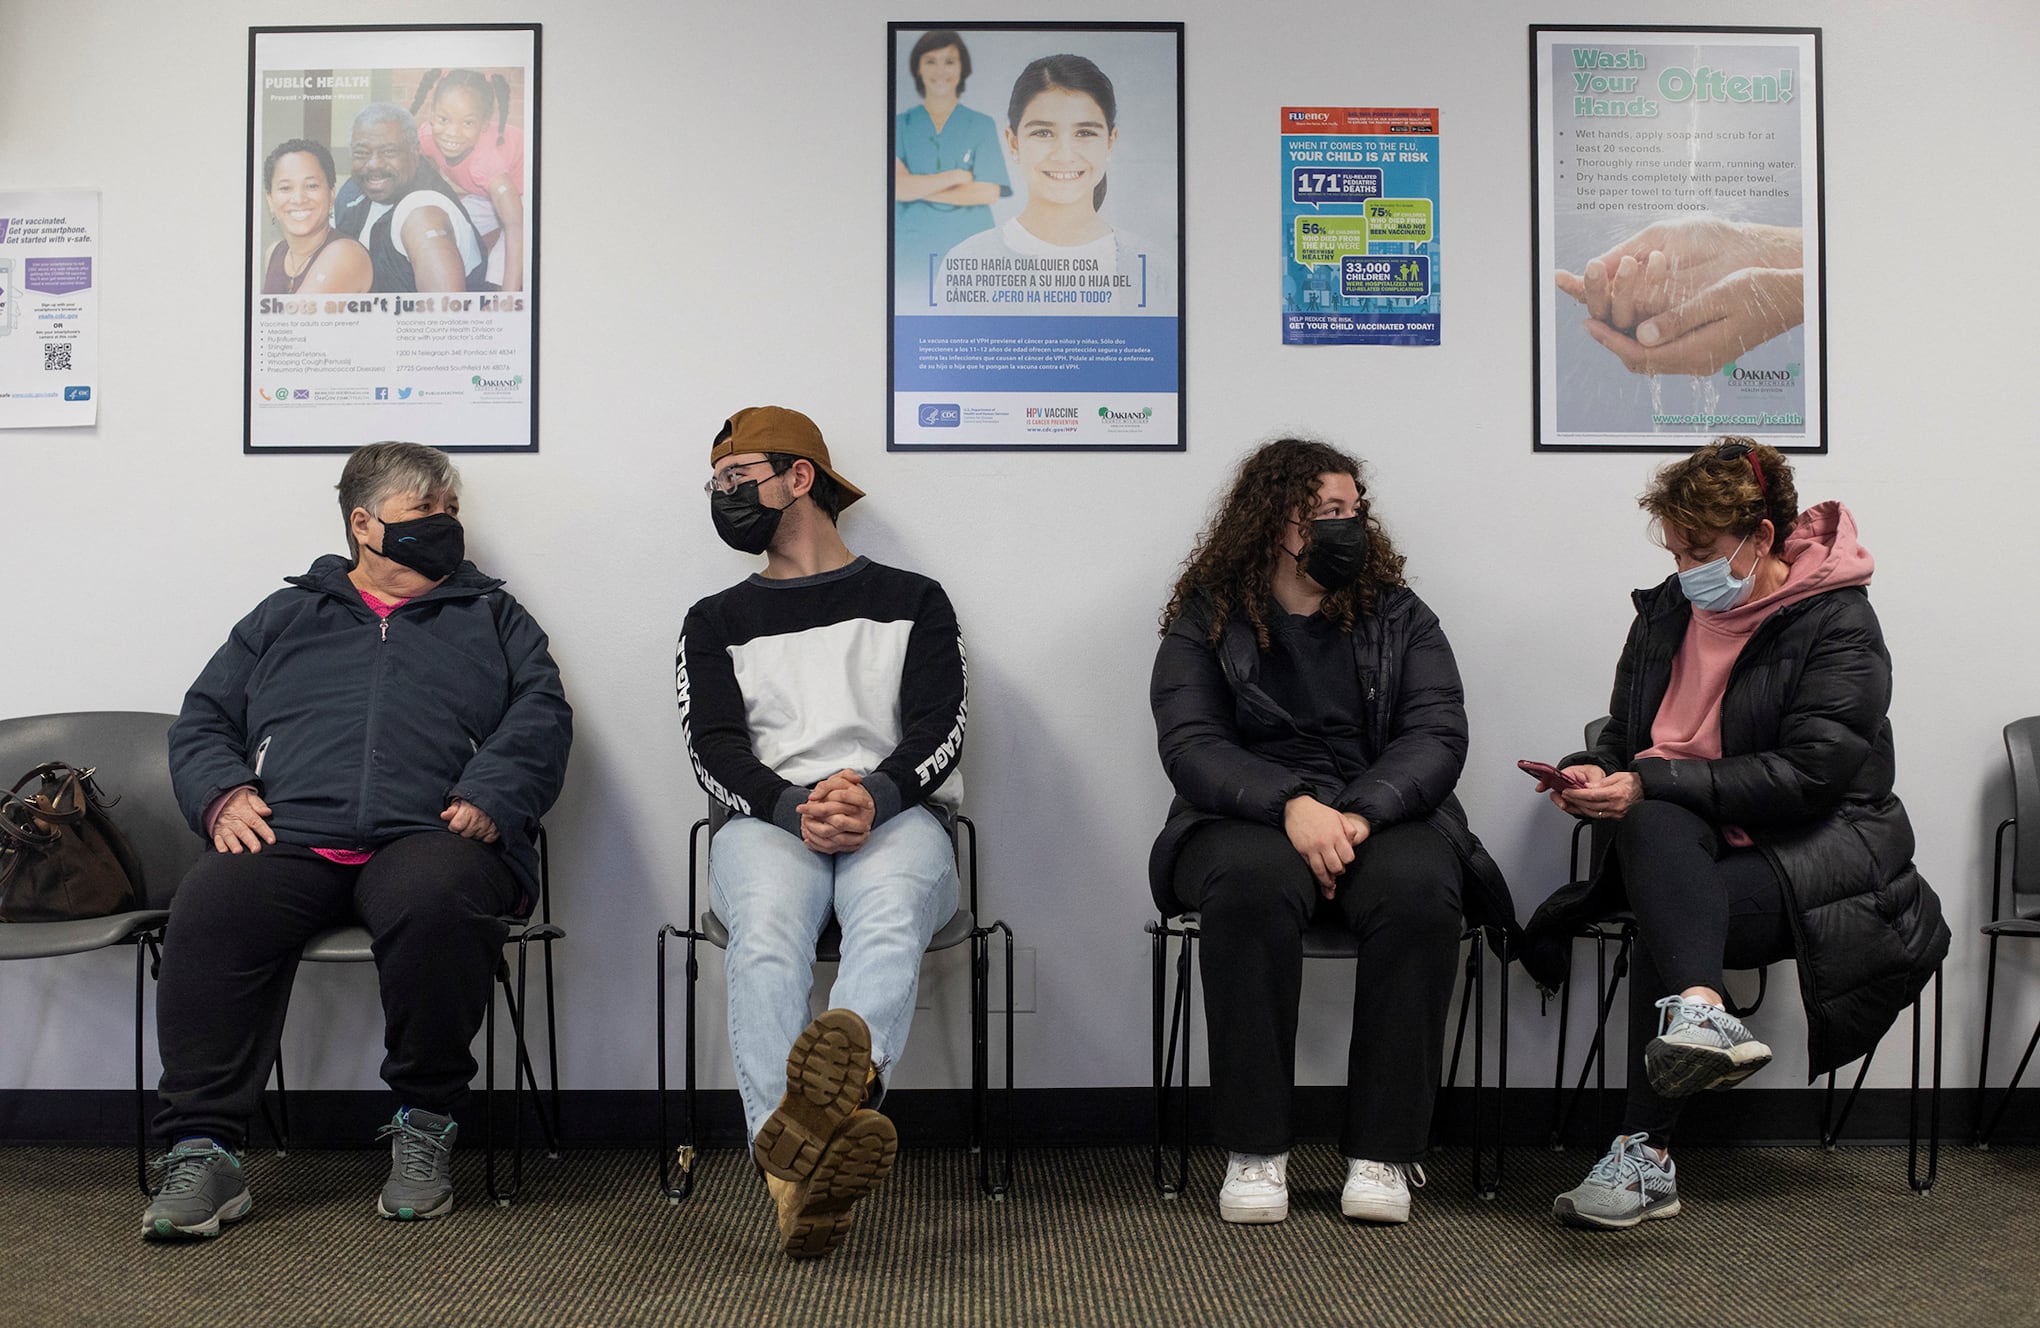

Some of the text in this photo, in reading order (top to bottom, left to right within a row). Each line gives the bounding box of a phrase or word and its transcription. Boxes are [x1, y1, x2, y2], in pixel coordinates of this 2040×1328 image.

[1572, 48, 1646, 69] Wash
[265, 76, 369, 89] PUBLIC HEALTH
[1573, 72, 1638, 93] Your
[1657, 66, 1793, 104] Often!
[1574, 96, 1658, 117] Hands
[1289, 112, 1329, 122] FLUency
[1576, 130, 1595, 138] Wet
[1598, 130, 1632, 138] hands,
[1635, 130, 1663, 140] apply
[1666, 132, 1692, 140] soap
[1330, 142, 1362, 150] COMES
[1576, 144, 1600, 152] least
[1289, 152, 1429, 162] YOUR CHILD IS AT RISK
[1576, 158, 1796, 170] Thoroughly rinse under warm, running water.
[1576, 172, 1776, 184] Dry hands completely with paper towel.
[1576, 187, 1596, 196] Use
[1600, 188, 1628, 197] paper
[1632, 188, 1658, 196] towel
[1698, 188, 1712, 196] off
[1715, 188, 1746, 196] faucet
[1750, 188, 1790, 197] handles
[1371, 208, 1392, 216] 75%
[1576, 202, 1596, 210] and
[1598, 203, 1624, 211] open
[1676, 202, 1710, 210] doors.
[1302, 223, 1326, 235] 56%
[946, 256, 1099, 272] USTED HARÍA CUALQUIER COSA
[1346, 263, 1391, 273] 33,000
[946, 274, 1132, 288] PARA PROTEGER A SU HIJO O HIJA DEL
[946, 288, 1112, 304] CÁNCER. ¿PERO HA HECHO TODO?
[260, 295, 524, 316] Shots aren't just for kids
[1732, 368, 1790, 381] OAKLAND
[1026, 408, 1079, 418] HPV VACCINE
[1653, 412, 1803, 426] www.oakgov.com/health
[914, 724, 963, 787] EAGLE
